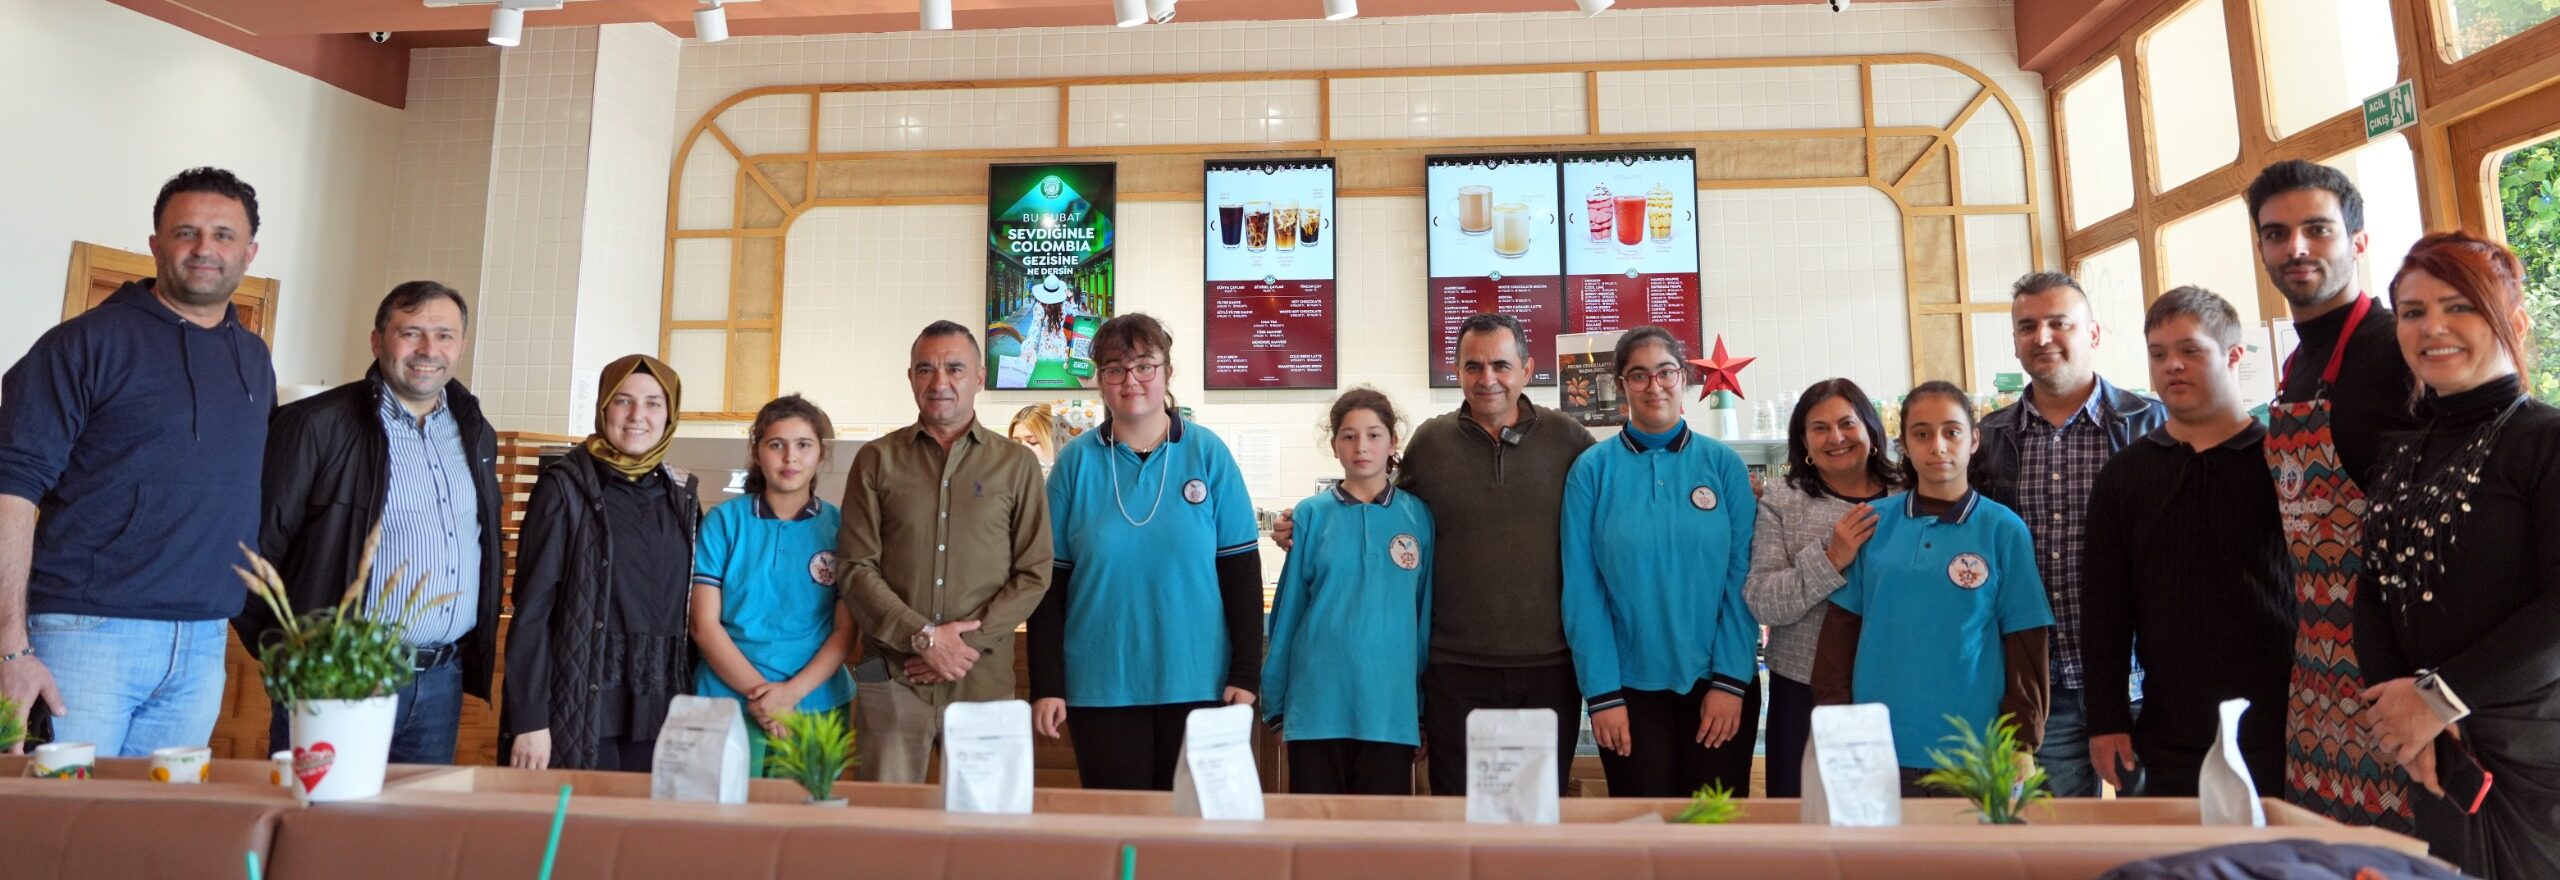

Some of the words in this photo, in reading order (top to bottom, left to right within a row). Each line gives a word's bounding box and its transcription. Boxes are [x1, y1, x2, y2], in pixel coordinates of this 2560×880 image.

[2369, 97, 2386, 114] ACİL
[2369, 114, 2390, 132] ÇIKIŞ
[1023, 213, 1039, 222] BU
[1043, 212, 1081, 223] UBAT
[1008, 224, 1095, 240] SEVDİĞİNLE
[1011, 240, 1092, 253] COLOMBIA
[1022, 253, 1079, 266] GEZİSİNE
[1027, 267, 1040, 275] NE
[1040, 265, 1074, 275] DERSİN
